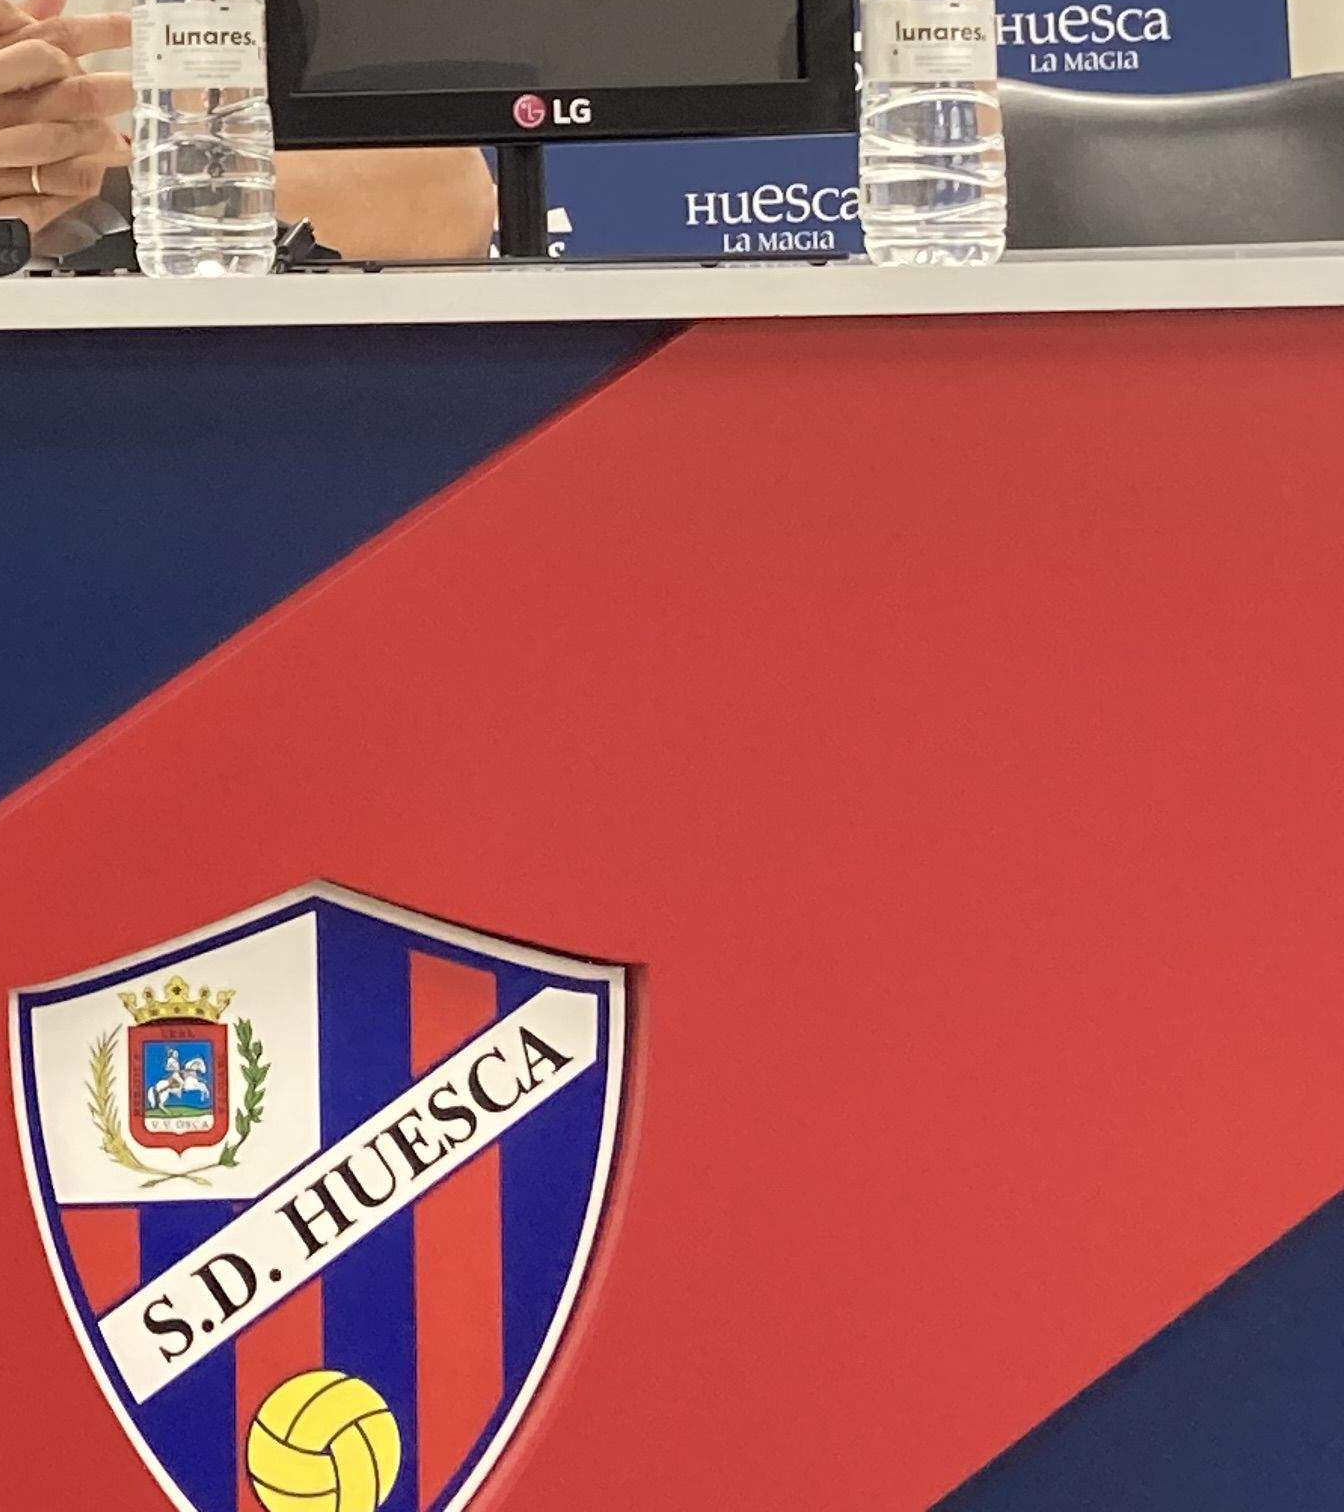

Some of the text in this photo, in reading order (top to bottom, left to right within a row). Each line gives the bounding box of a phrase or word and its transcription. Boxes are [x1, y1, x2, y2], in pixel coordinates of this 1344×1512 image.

[554, 99, 591, 123] LG
[142, 1025, 573, 1362] S.D. HUESCA
